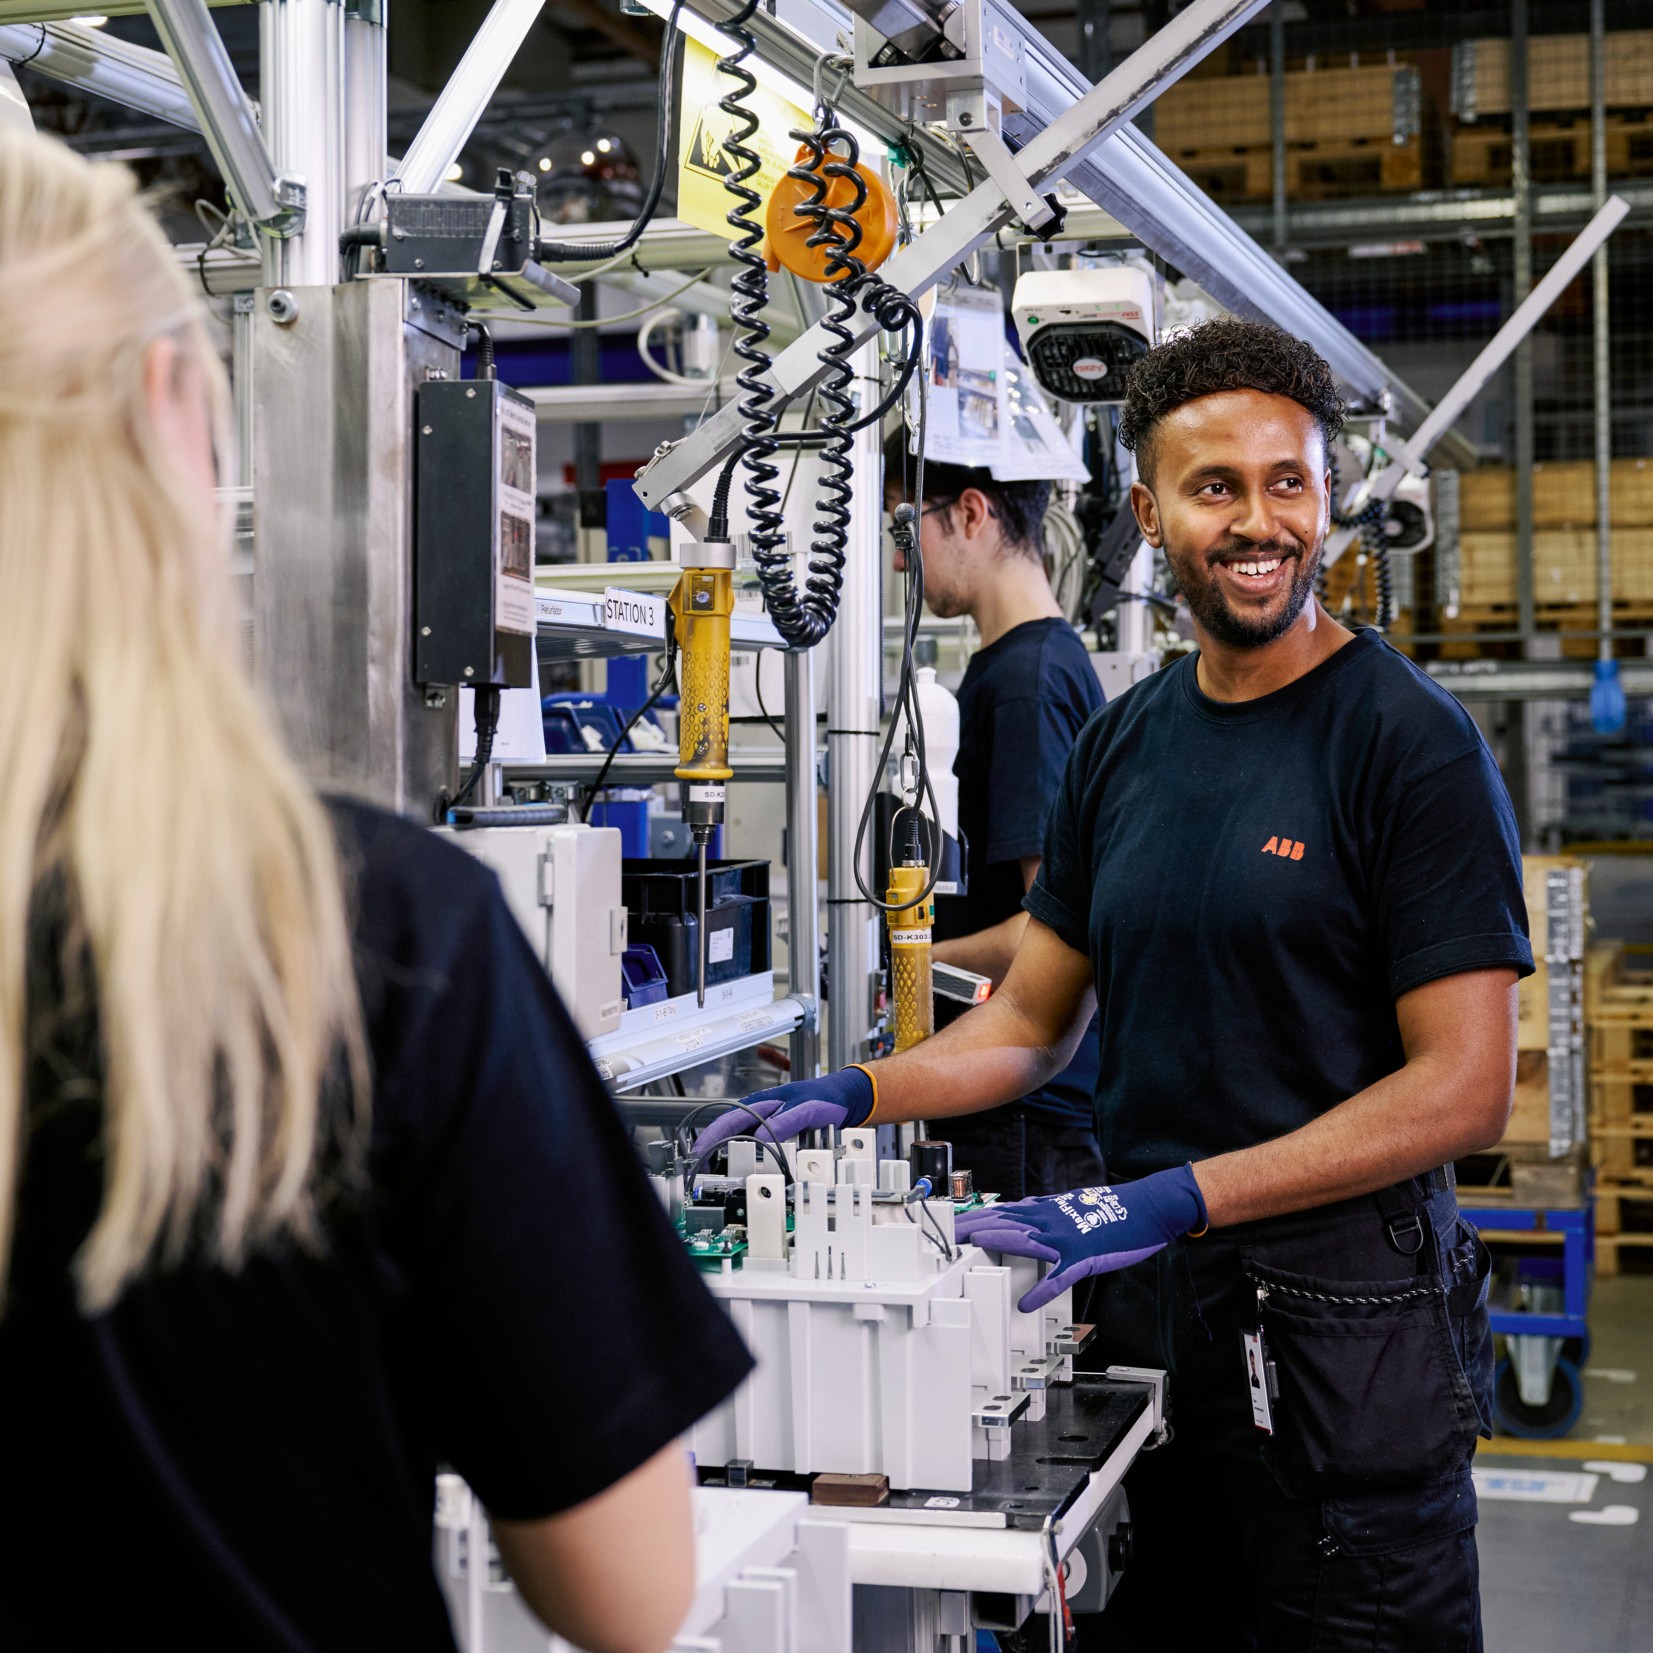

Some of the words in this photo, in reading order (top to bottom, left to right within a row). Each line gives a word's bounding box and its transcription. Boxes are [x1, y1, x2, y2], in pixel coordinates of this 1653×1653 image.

[606, 598, 647, 625] STATION
[648, 606, 655, 627] 3
[1260, 835, 1305, 861] ABB
[1053, 1195, 1093, 1235] MaxiFlex
